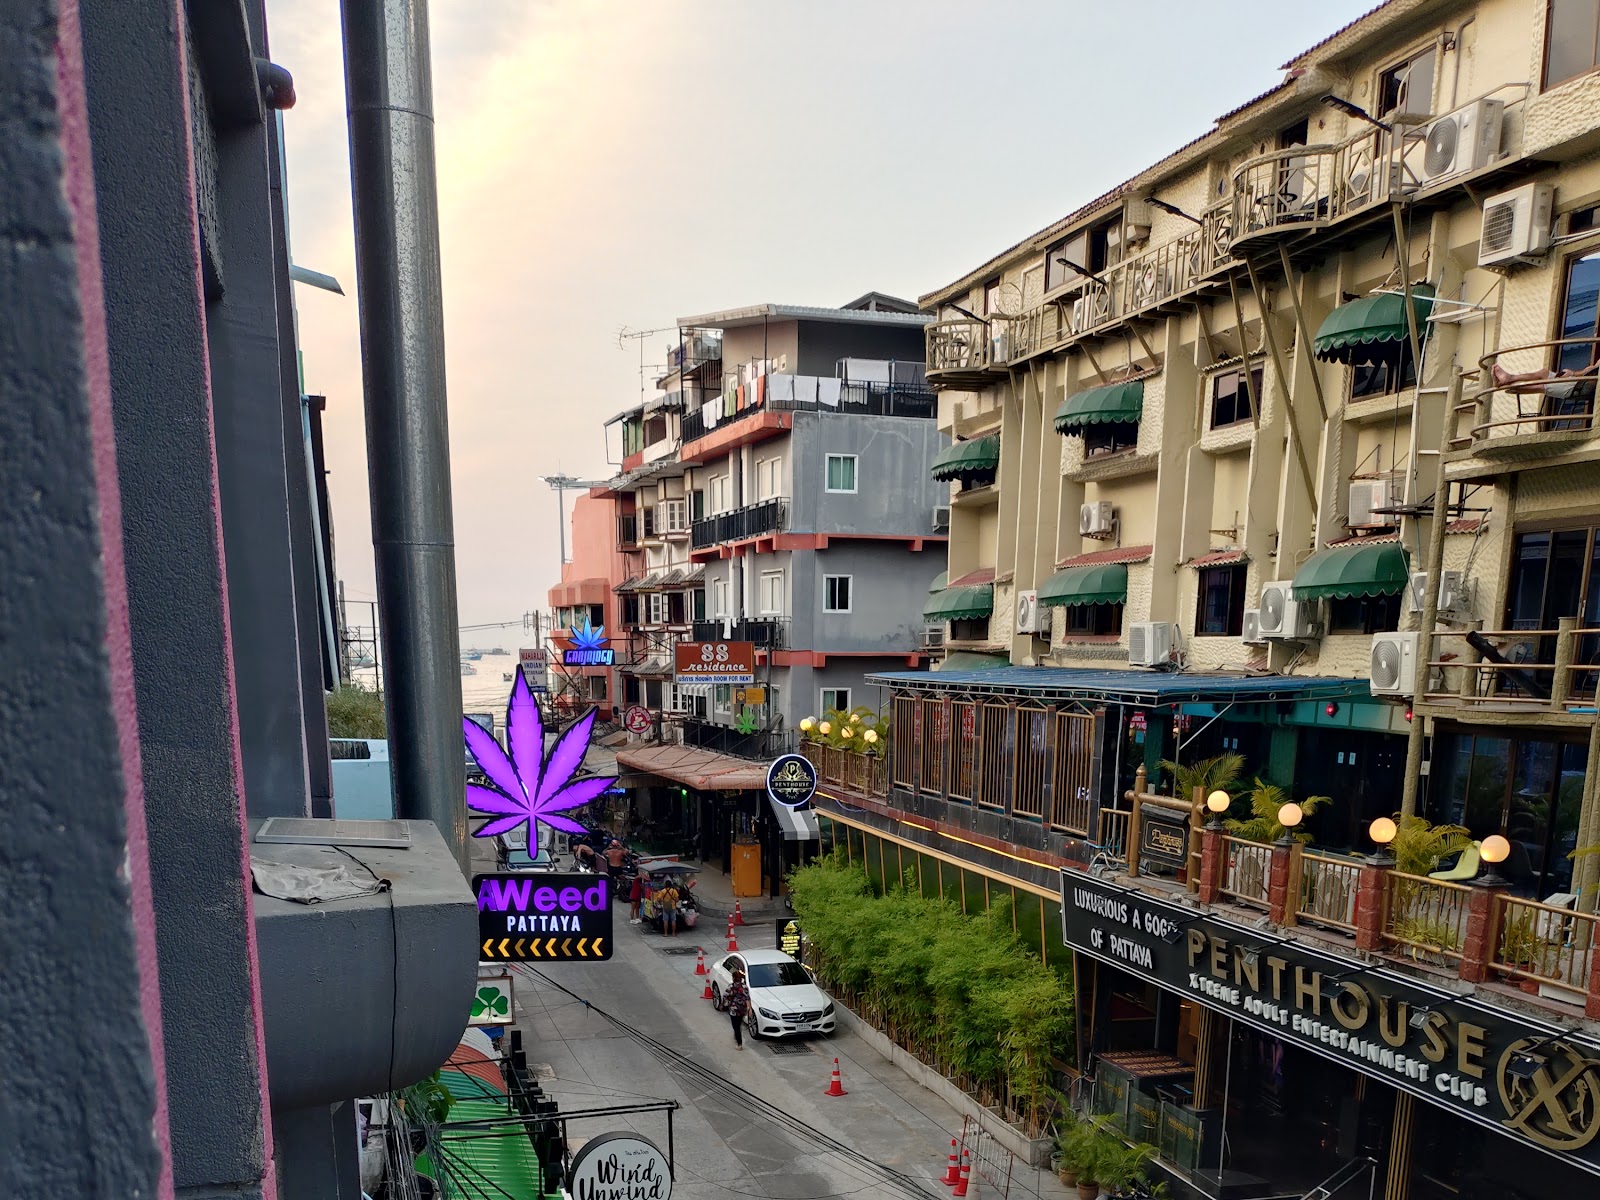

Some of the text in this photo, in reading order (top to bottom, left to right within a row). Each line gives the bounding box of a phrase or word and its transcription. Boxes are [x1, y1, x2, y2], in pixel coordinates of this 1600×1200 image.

[566, 650, 613, 665] GANJALOGY
[682, 662, 748, 671] residence
[701, 643, 729, 662] SS
[507, 915, 580, 932] PATTAYA
[1074, 887, 1175, 940] LUXURIOUS A GOG
[1090, 928, 1153, 969] OF PATTAYA
[1187, 928, 1487, 1079] PENTHOUSE
[1243, 995, 1289, 1026] ADULT
[1292, 1014, 1430, 1082] ENTERTAINMENT
[1435, 1073, 1488, 1106] CLUB
